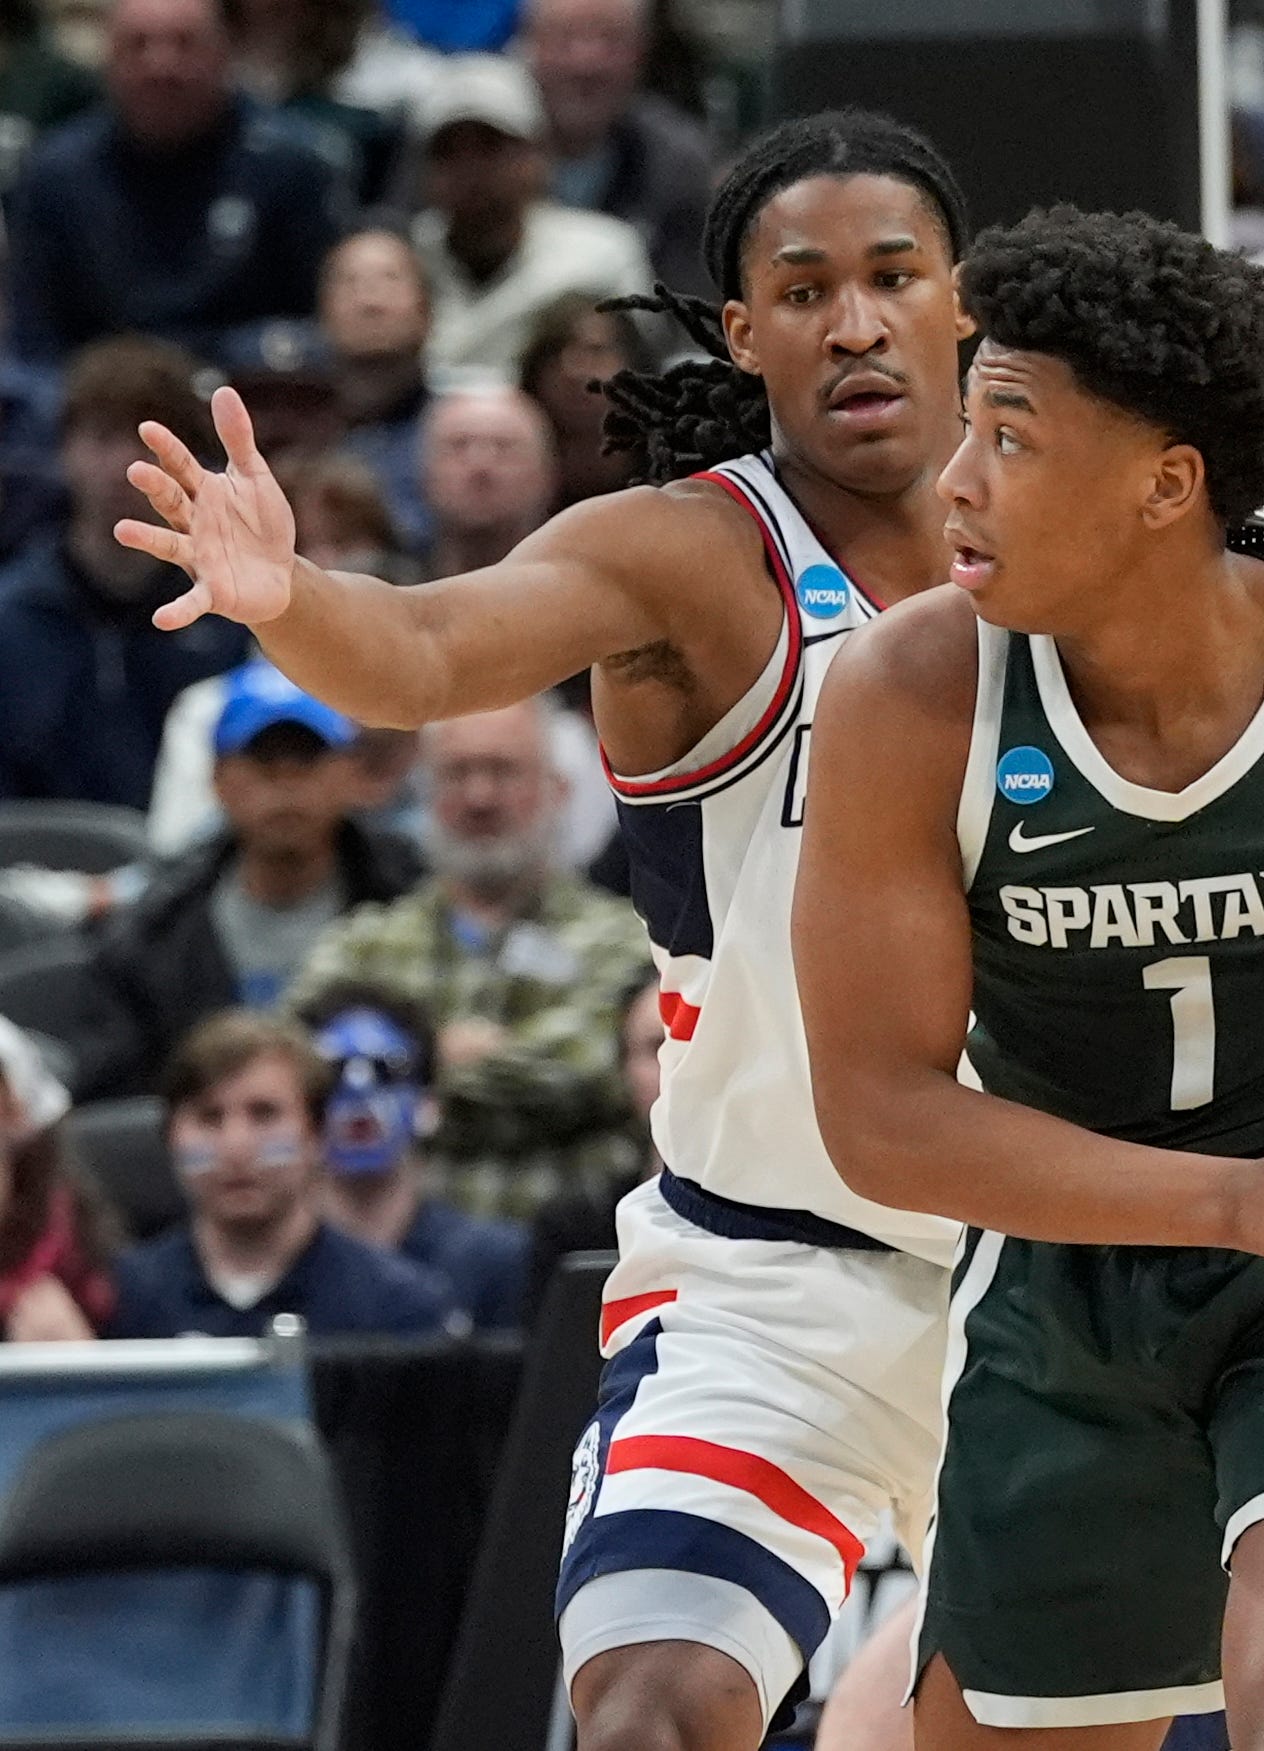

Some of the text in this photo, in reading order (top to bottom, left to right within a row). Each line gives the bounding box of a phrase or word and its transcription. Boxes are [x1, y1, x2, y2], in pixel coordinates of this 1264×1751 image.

[804, 588, 846, 606] NCAA
[1004, 773, 1051, 790] NCAA
[1142, 955, 1217, 1111] 1
